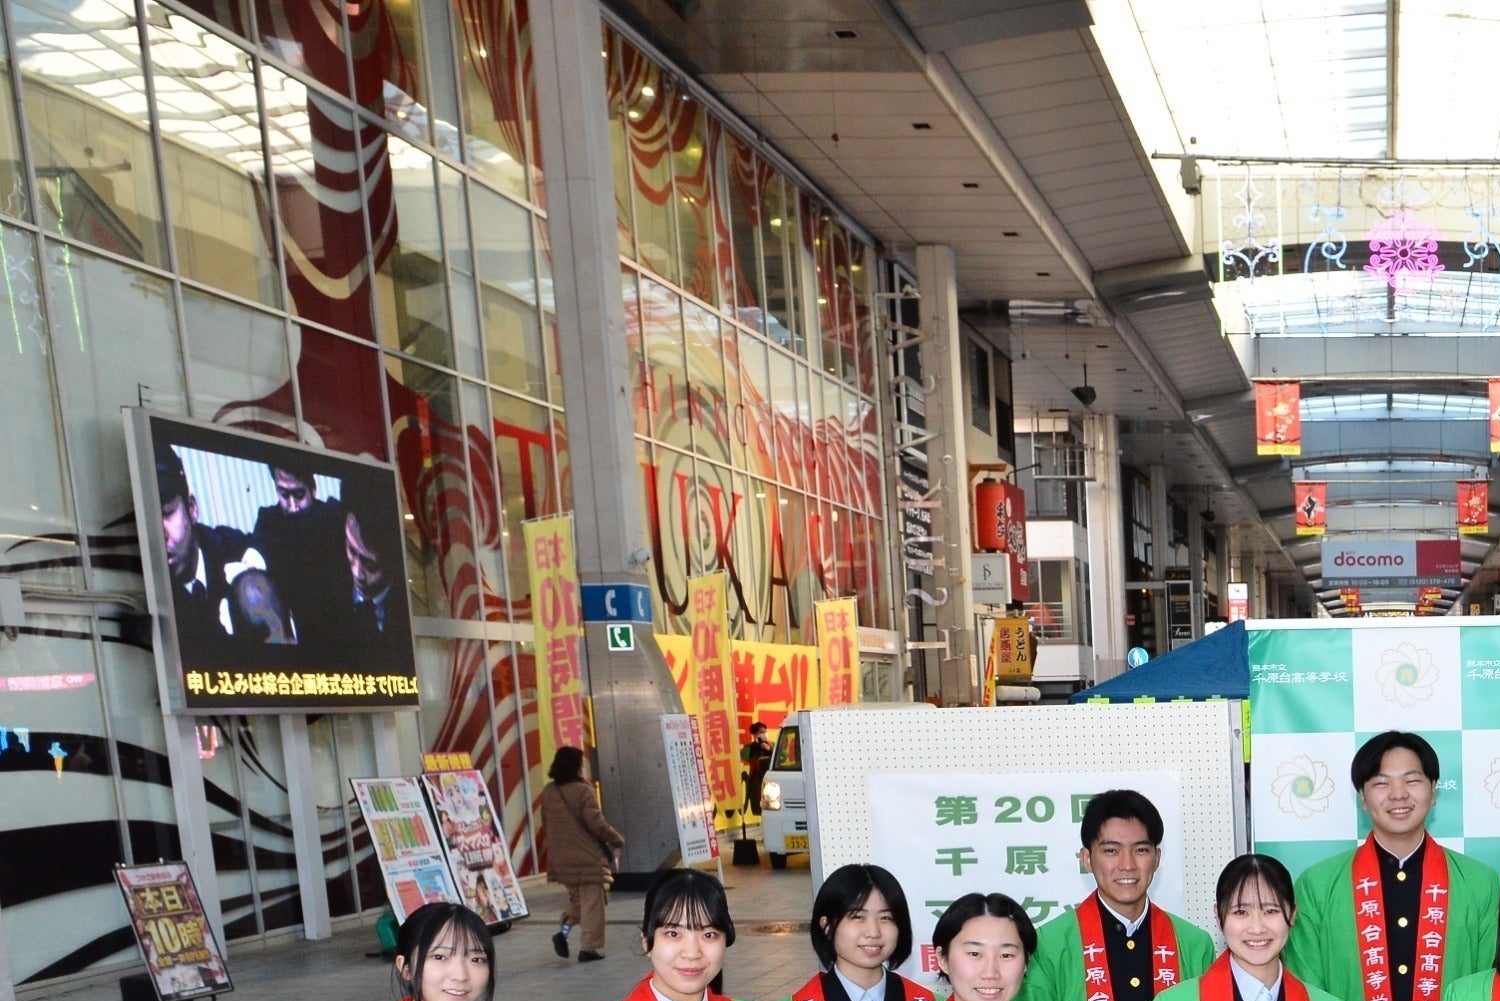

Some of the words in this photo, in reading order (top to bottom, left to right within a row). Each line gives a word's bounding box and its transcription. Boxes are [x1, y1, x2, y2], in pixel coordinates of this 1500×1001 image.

[1333, 551, 1404, 567] docomo
[1015, 626, 1028, 662] うどん
[935, 846, 1091, 876] 千原
[139, 885, 184, 914] 本日
[144, 917, 205, 956] 10時
[1153, 945, 1177, 986] 千原
